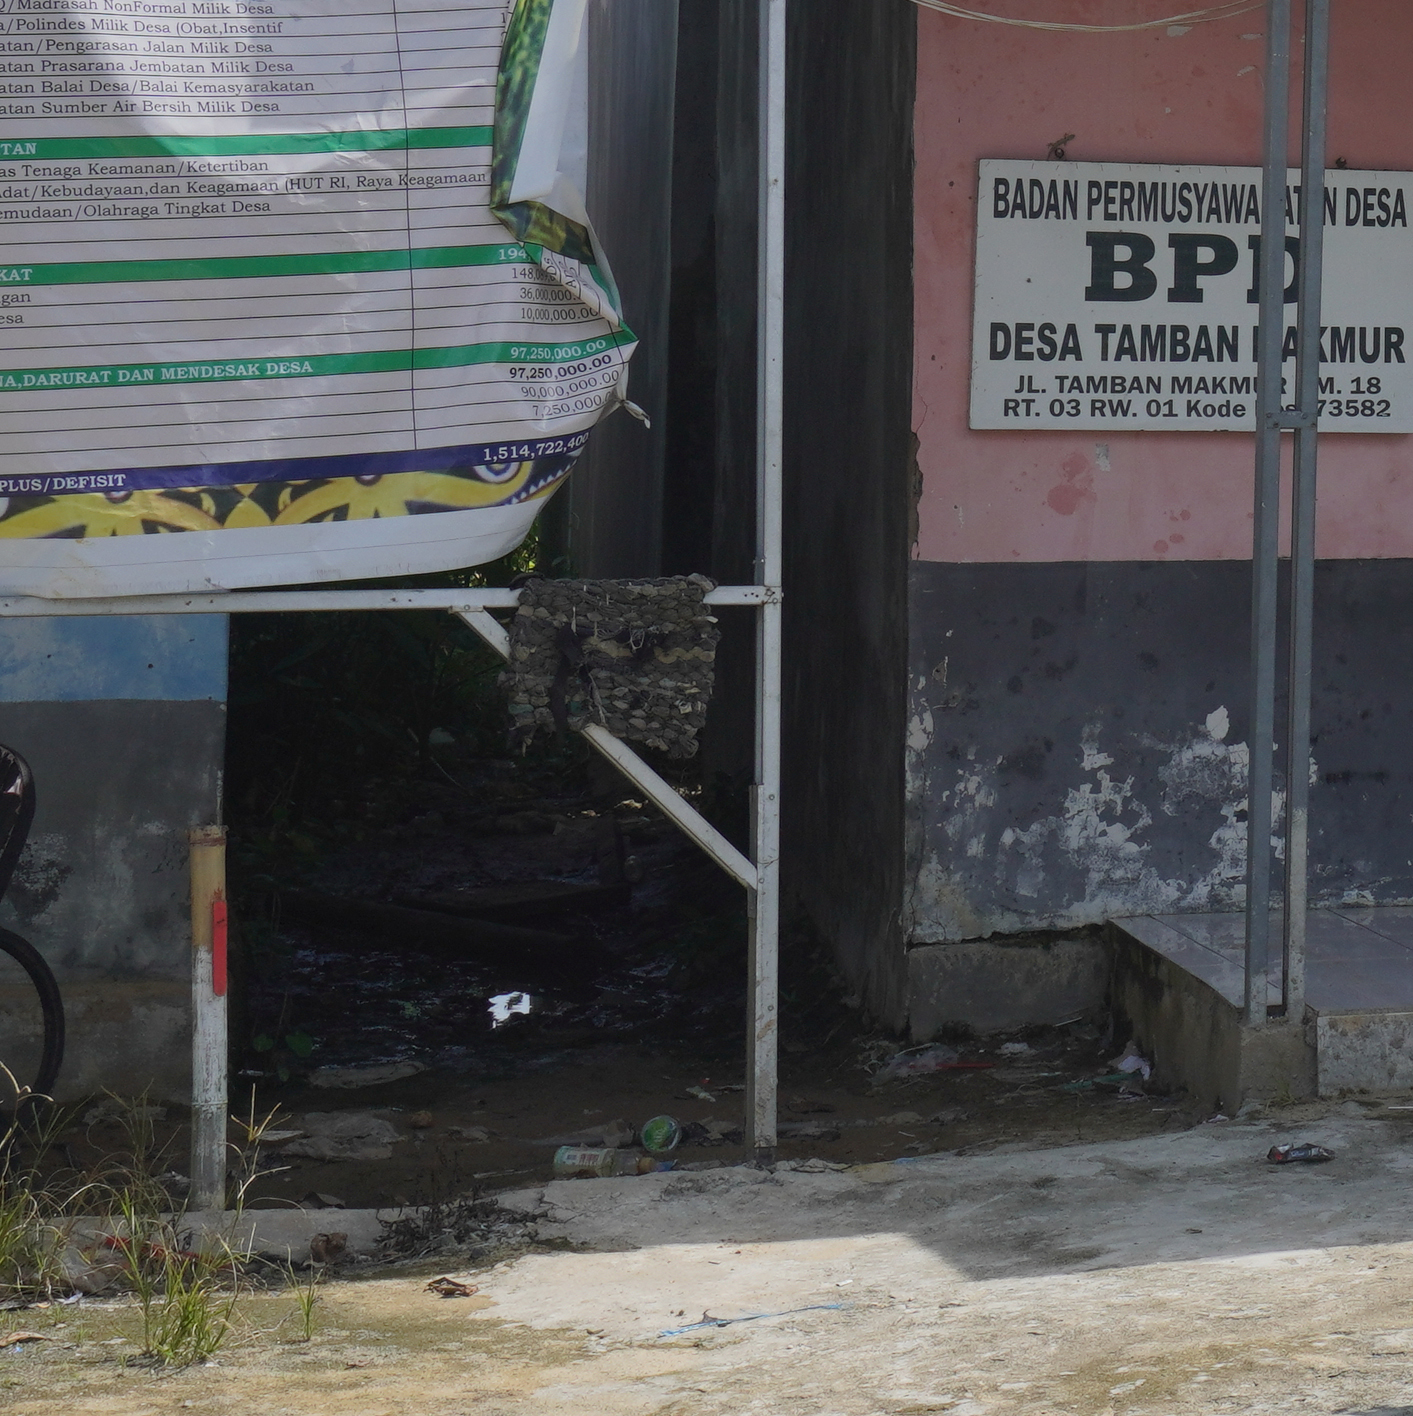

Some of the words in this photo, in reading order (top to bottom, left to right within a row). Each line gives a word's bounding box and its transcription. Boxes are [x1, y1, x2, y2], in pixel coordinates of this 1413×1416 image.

[130, 60, 205, 73] Jembatan
[211, 61, 250, 72] Milik
[255, 61, 294, 72] Desa
[993, 178, 1077, 220] BADAN
[1346, 187, 1407, 227] DESA
[1084, 231, 1302, 304] BPD
[510, 339, 606, 359] 97,250,000.00
[989, 322, 1083, 361] DESA
[1095, 324, 1238, 363] TAMBAN
[118, 369, 153, 381] DAN
[161, 364, 260, 379] MENDESAK
[266, 362, 313, 374] DESA
[1015, 376, 1046, 394] JL.
[1055, 376, 1162, 394] TAMBAN
[1350, 376, 1381, 394] 18
[1003, 399, 1040, 417] RT.
[1049, 399, 1081, 417] 03
[1090, 399, 1137, 418] RW.
[1146, 399, 1178, 418] 01
[1186, 399, 1246, 418] Kode
[1315, 399, 1390, 418] 73582
